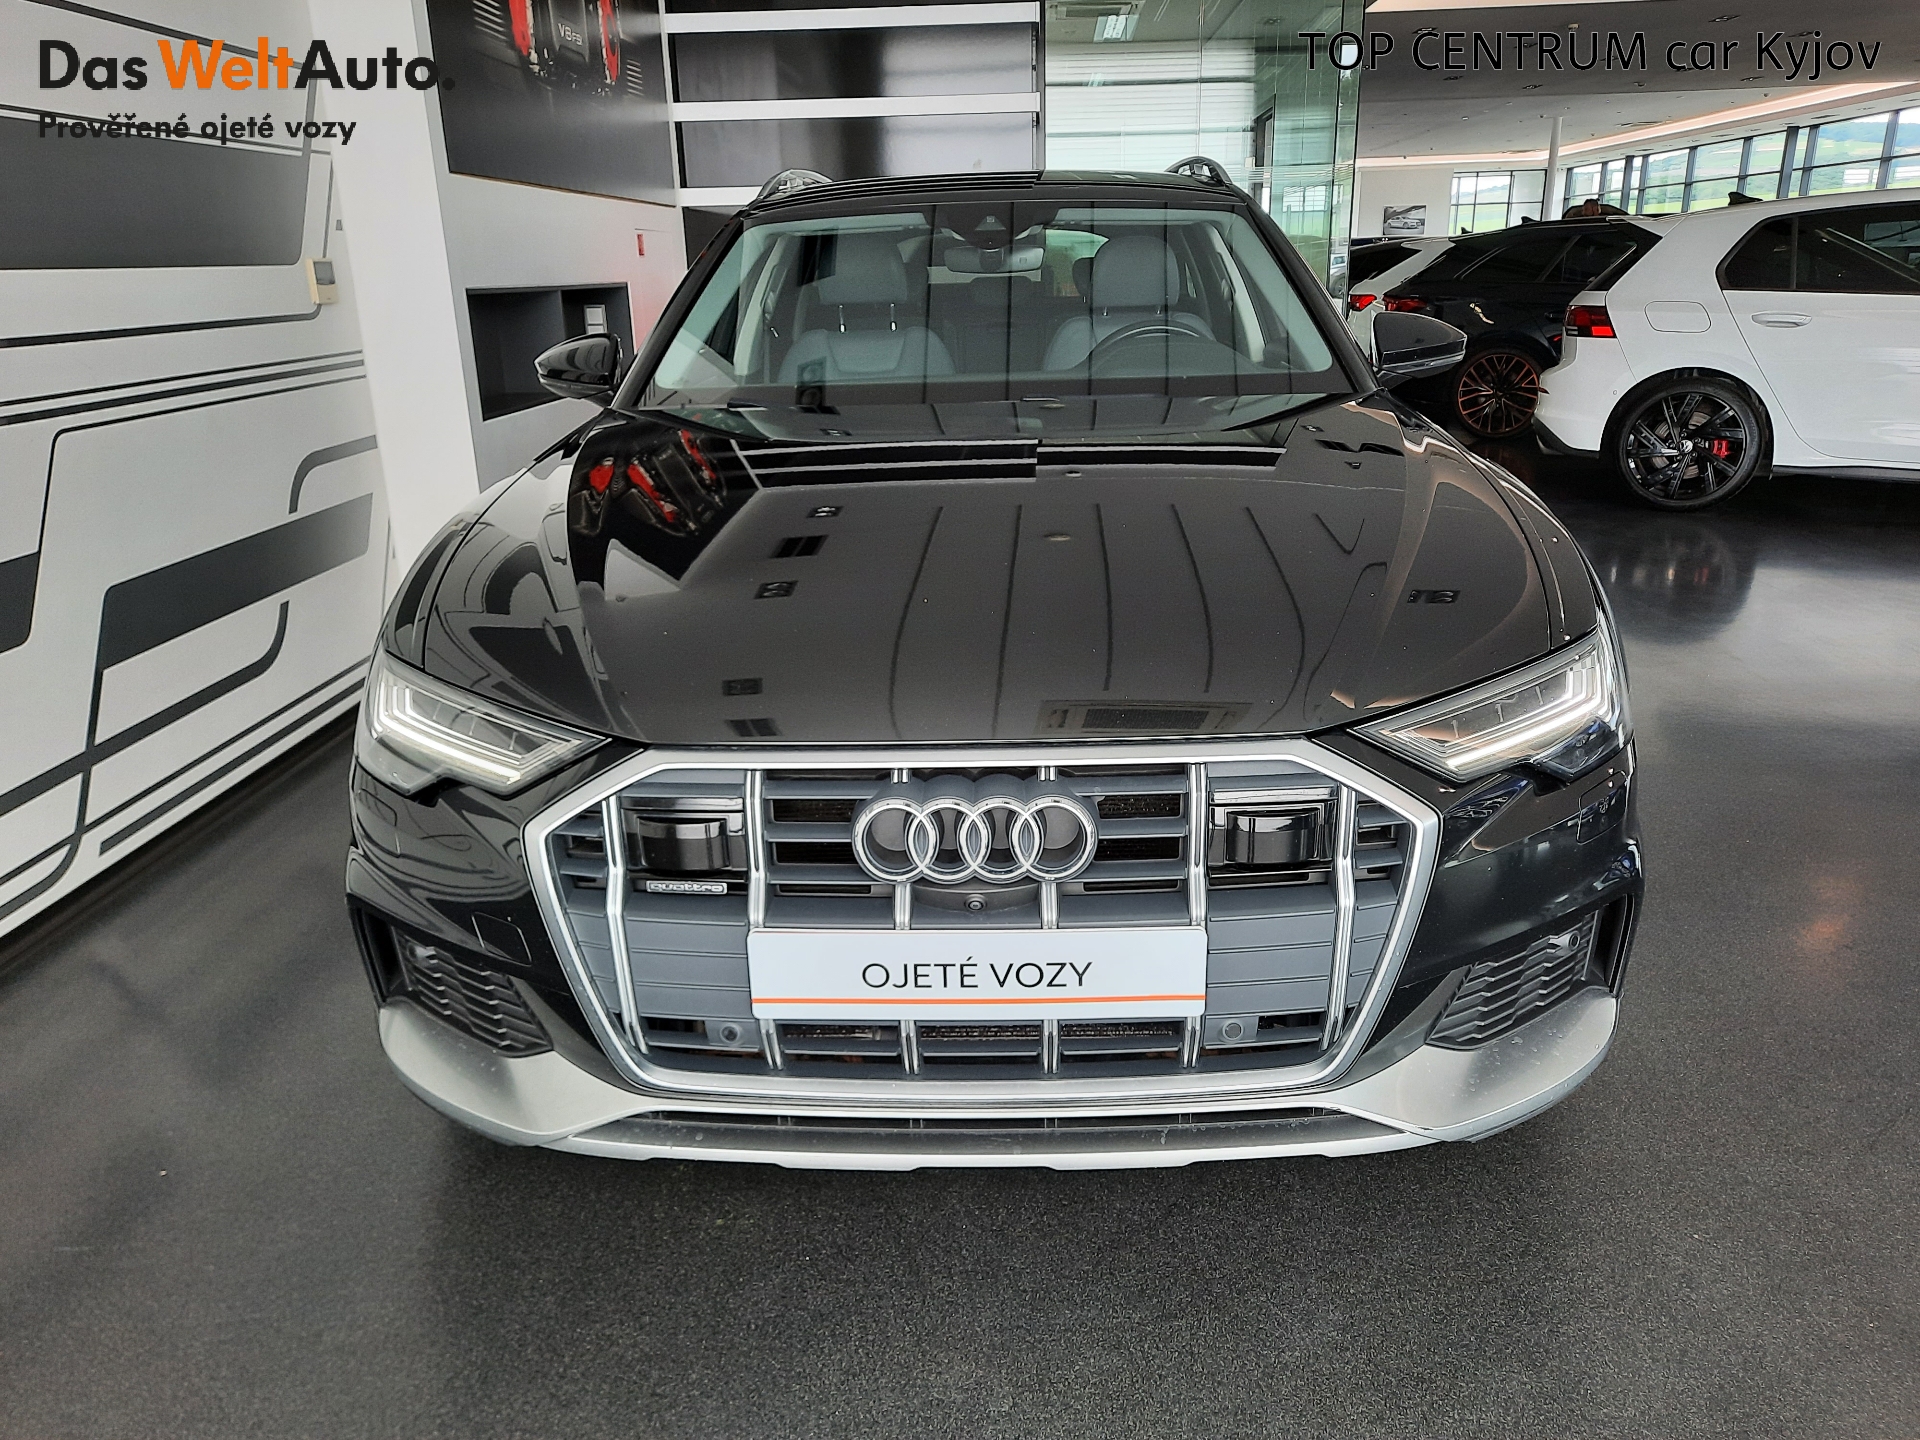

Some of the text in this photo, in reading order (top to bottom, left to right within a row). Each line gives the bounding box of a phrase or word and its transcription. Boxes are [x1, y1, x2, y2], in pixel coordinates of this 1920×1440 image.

[649, 883, 724, 892] quattro
[862, 956, 1093, 989] OJETÉ VOZY
